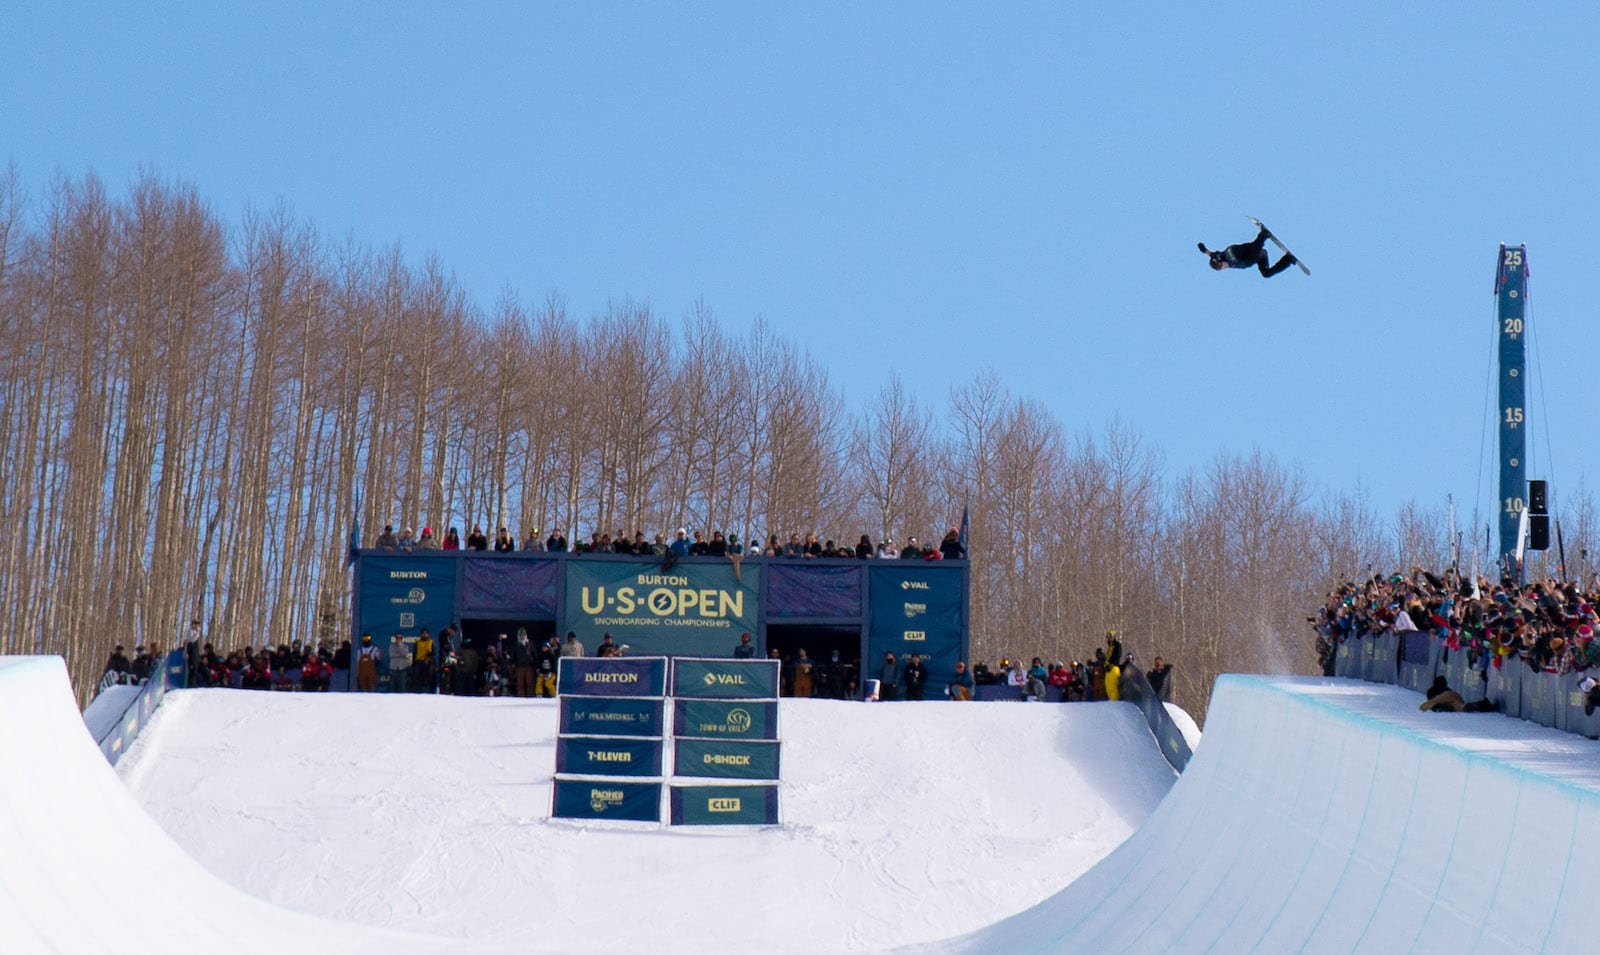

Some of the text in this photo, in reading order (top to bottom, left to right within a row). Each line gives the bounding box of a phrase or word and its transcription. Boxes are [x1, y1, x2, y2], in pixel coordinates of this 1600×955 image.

[1504, 251, 1522, 266] 25
[1504, 318, 1523, 333] 20
[1505, 407, 1523, 422] 15
[1505, 497, 1523, 513] 10
[390, 570, 427, 579] BURTON
[637, 574, 688, 586] BURTON
[910, 581, 930, 589] VAIL
[594, 617, 731, 628] SNOWBOARDING CHAMPIONSHIPS
[584, 672, 638, 683] BURTON
[717, 673, 745, 685] VAIL
[712, 800, 737, 809] CLIF
